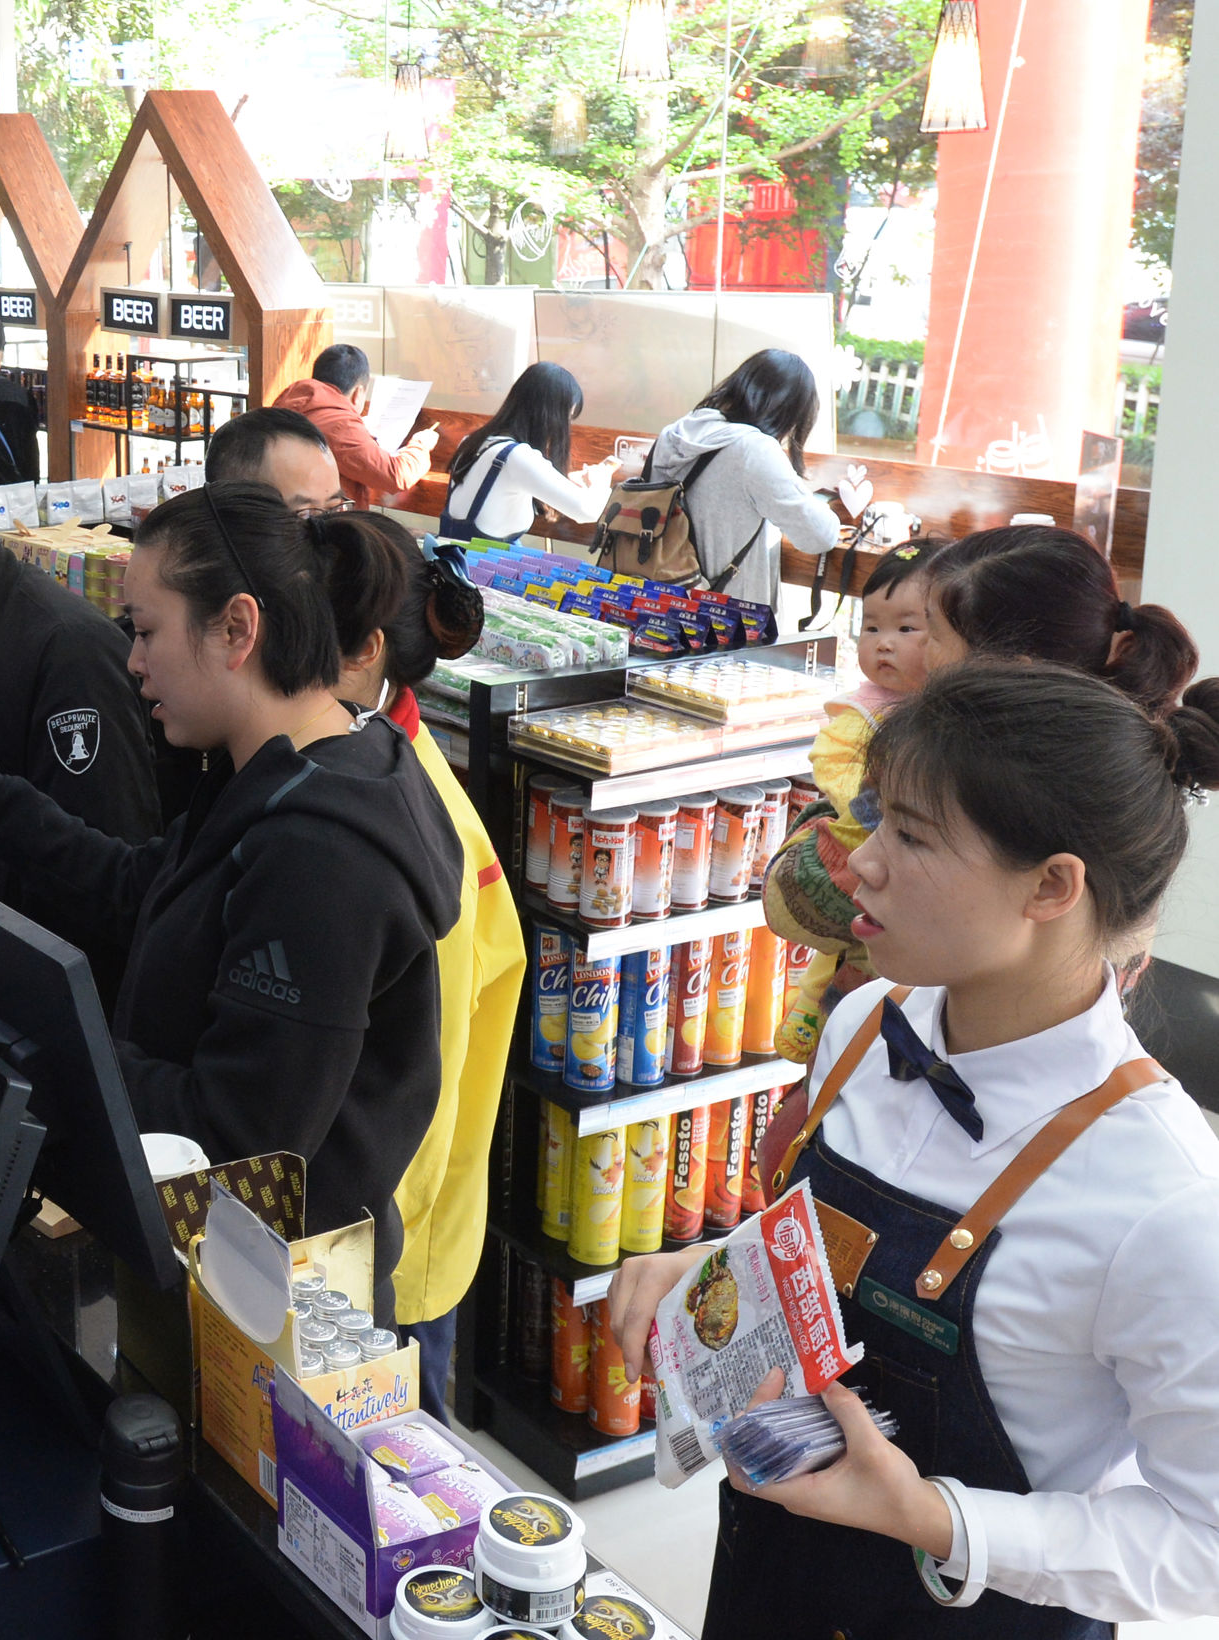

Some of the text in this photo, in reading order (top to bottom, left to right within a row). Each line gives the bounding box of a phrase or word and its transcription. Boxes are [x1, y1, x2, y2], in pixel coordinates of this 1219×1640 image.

[0, 295, 33, 318] BEER
[112, 298, 154, 325] BEER
[180, 304, 225, 332] BEER
[228, 967, 302, 1004] adidas
[674, 1118, 692, 1188] Fessto
[726, 1106, 742, 1177] Fessto
[782, 1278, 811, 1355] WEST KITCHEN GOD
[790, 1263, 841, 1380] 西部厨神
[407, 1575, 462, 1599] Benechew
[583, 1612, 634, 1640] enechew
